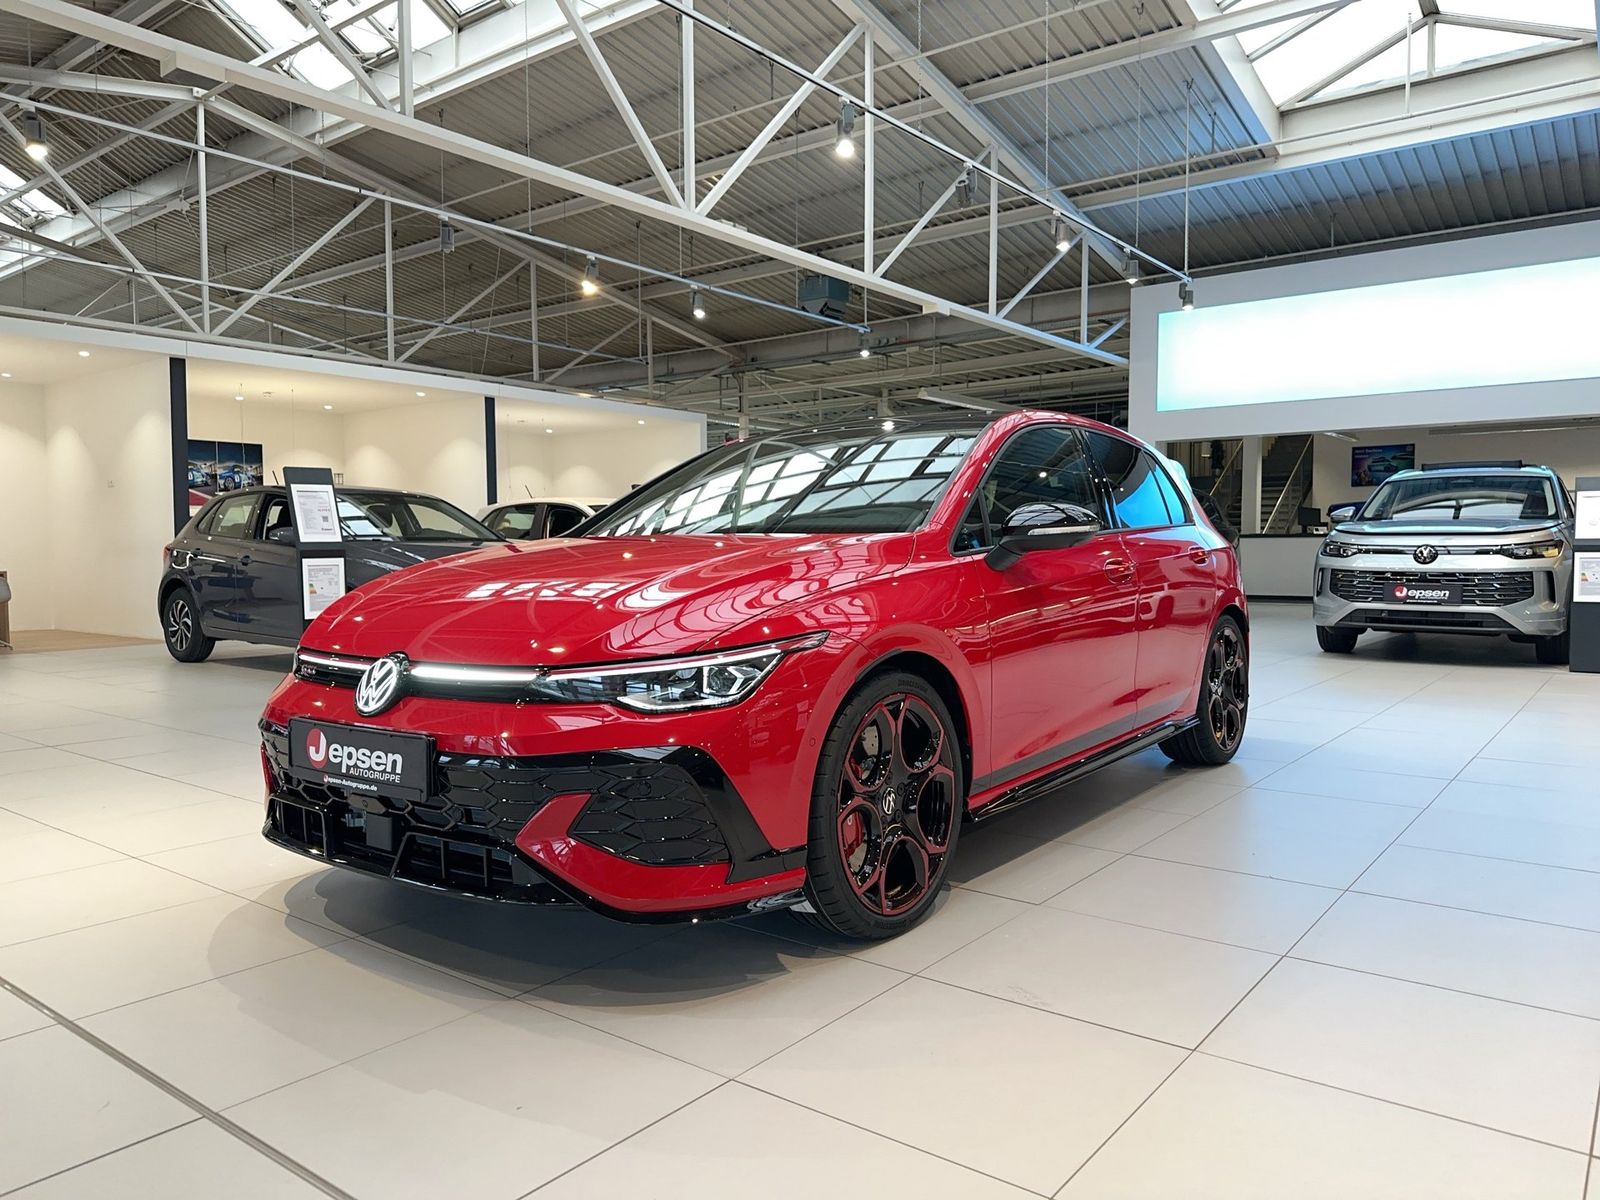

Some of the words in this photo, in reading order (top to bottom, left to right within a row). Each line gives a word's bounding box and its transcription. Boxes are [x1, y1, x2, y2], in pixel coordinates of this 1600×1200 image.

[1395, 585, 1450, 599] Jepsen
[308, 730, 403, 774] Jepsen
[323, 774, 378, 792] Jepsen-Autogruppe.de
[349, 766, 401, 783] AUTOGRUPPE
